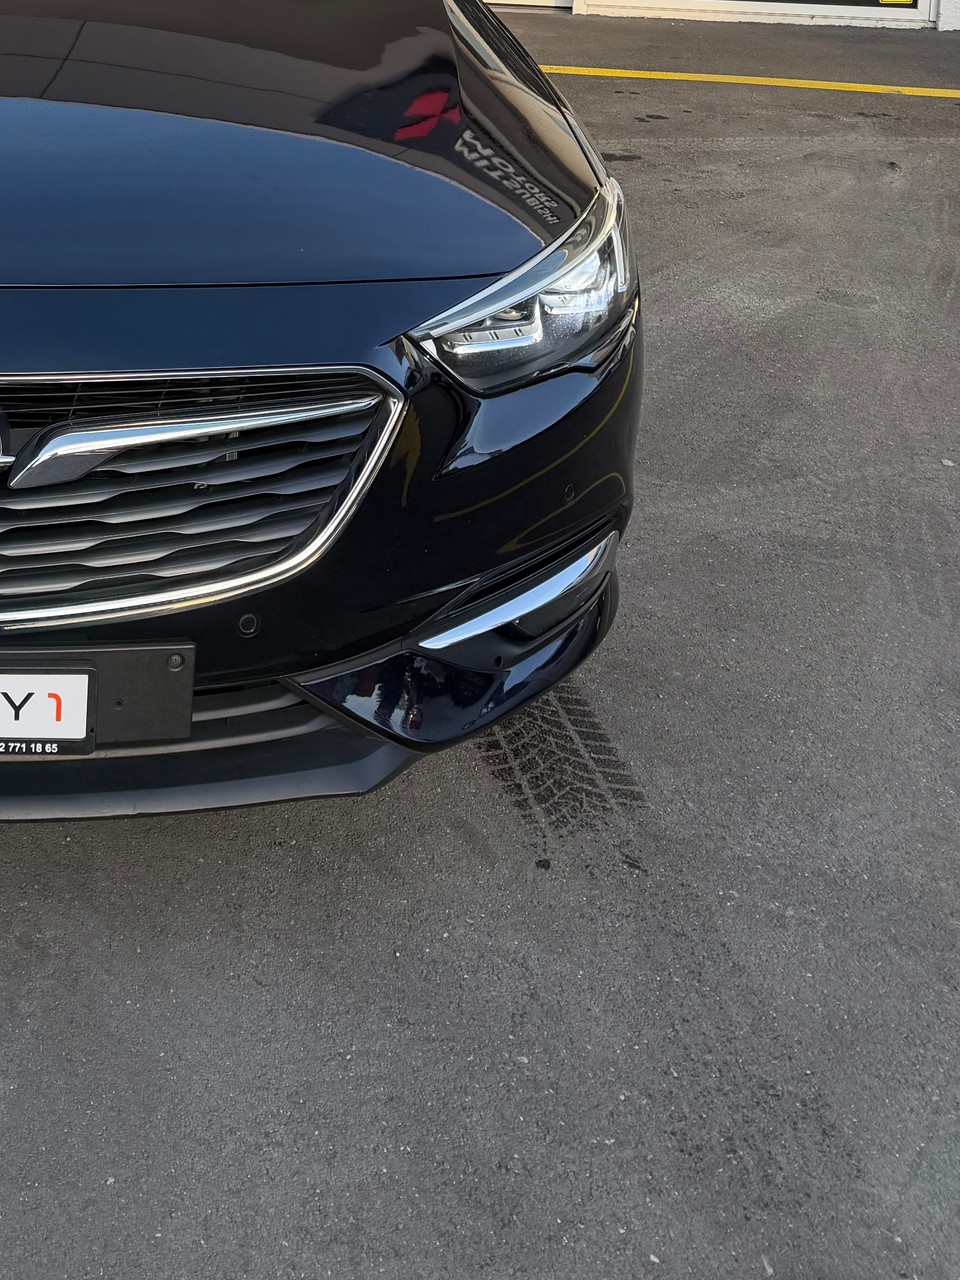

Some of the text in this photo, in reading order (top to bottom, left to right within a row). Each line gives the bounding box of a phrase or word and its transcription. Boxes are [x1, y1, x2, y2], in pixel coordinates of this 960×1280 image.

[47, 692, 62, 722] 1
[8, 743, 27, 753] 771
[30, 743, 43, 753] 18
[45, 743, 58, 753] 65
